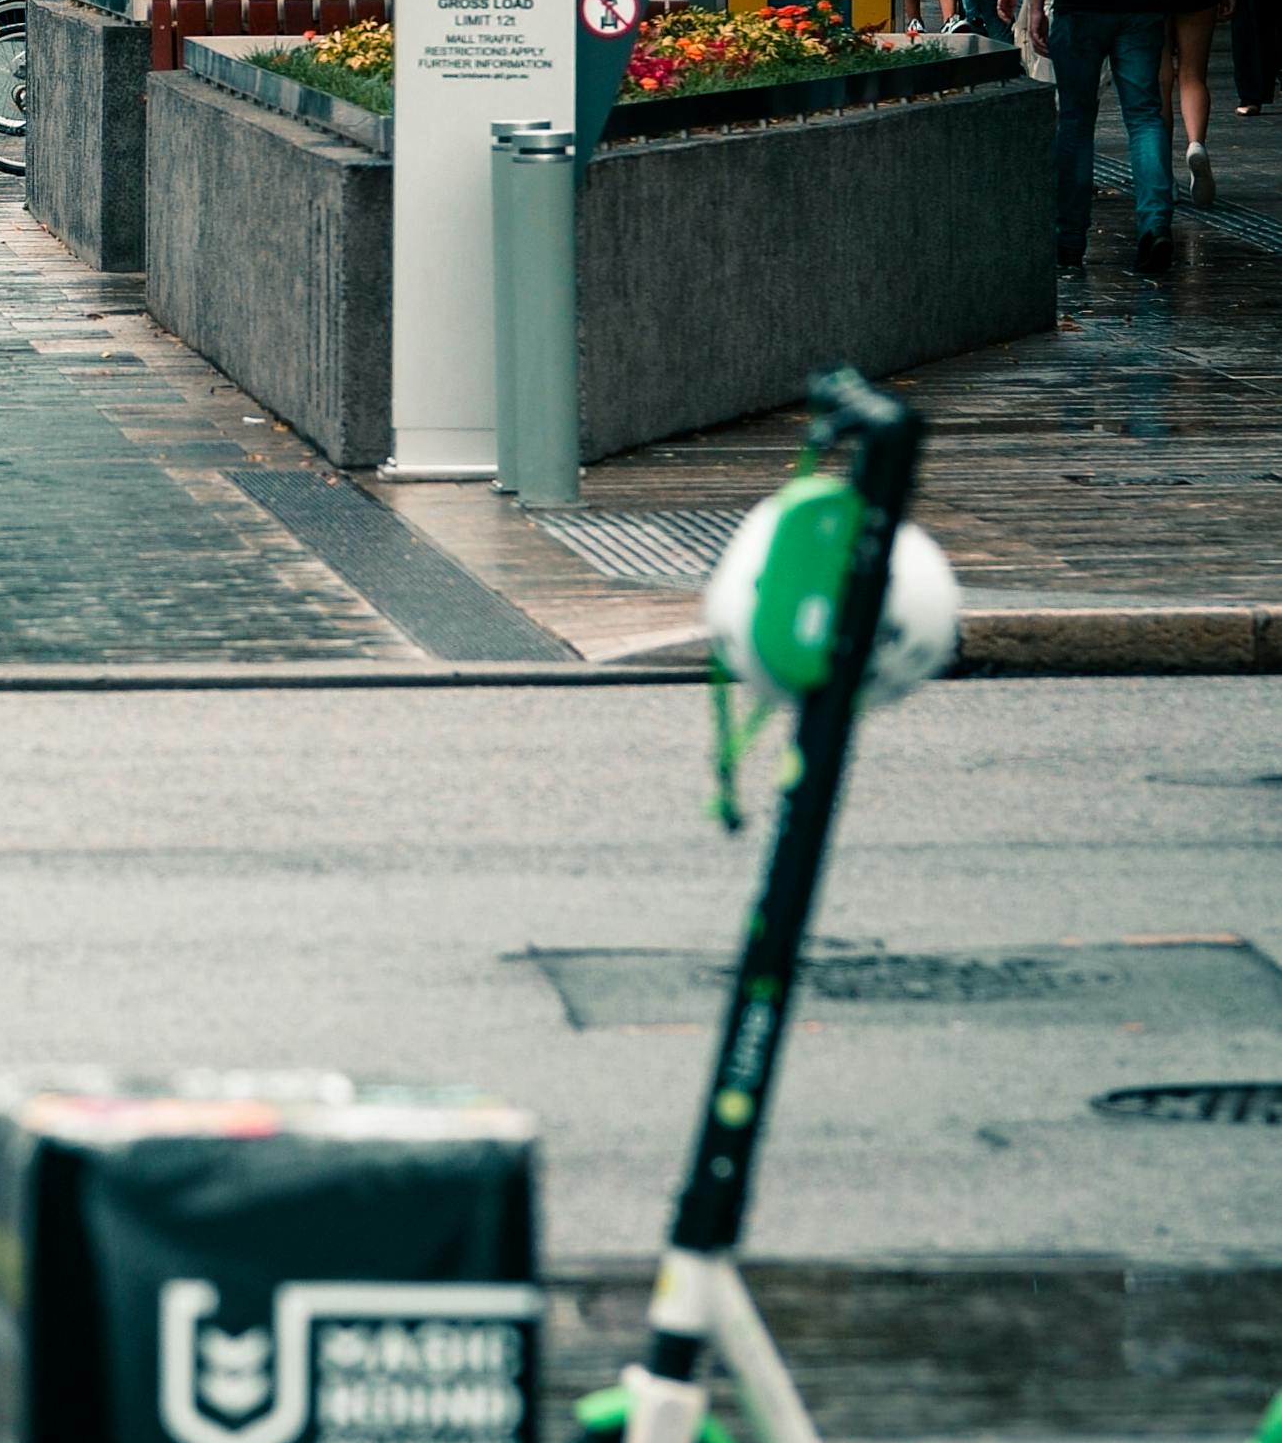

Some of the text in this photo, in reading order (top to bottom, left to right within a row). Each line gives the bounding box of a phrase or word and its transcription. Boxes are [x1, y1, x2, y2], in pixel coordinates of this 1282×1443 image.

[454, 15, 516, 26] LIMIT 12t
[445, 34, 525, 44] MALL TRAFFIC
[424, 46, 545, 57] RESTRICTIONS APPLY
[418, 59, 553, 69] FURTHER INFORMATION
